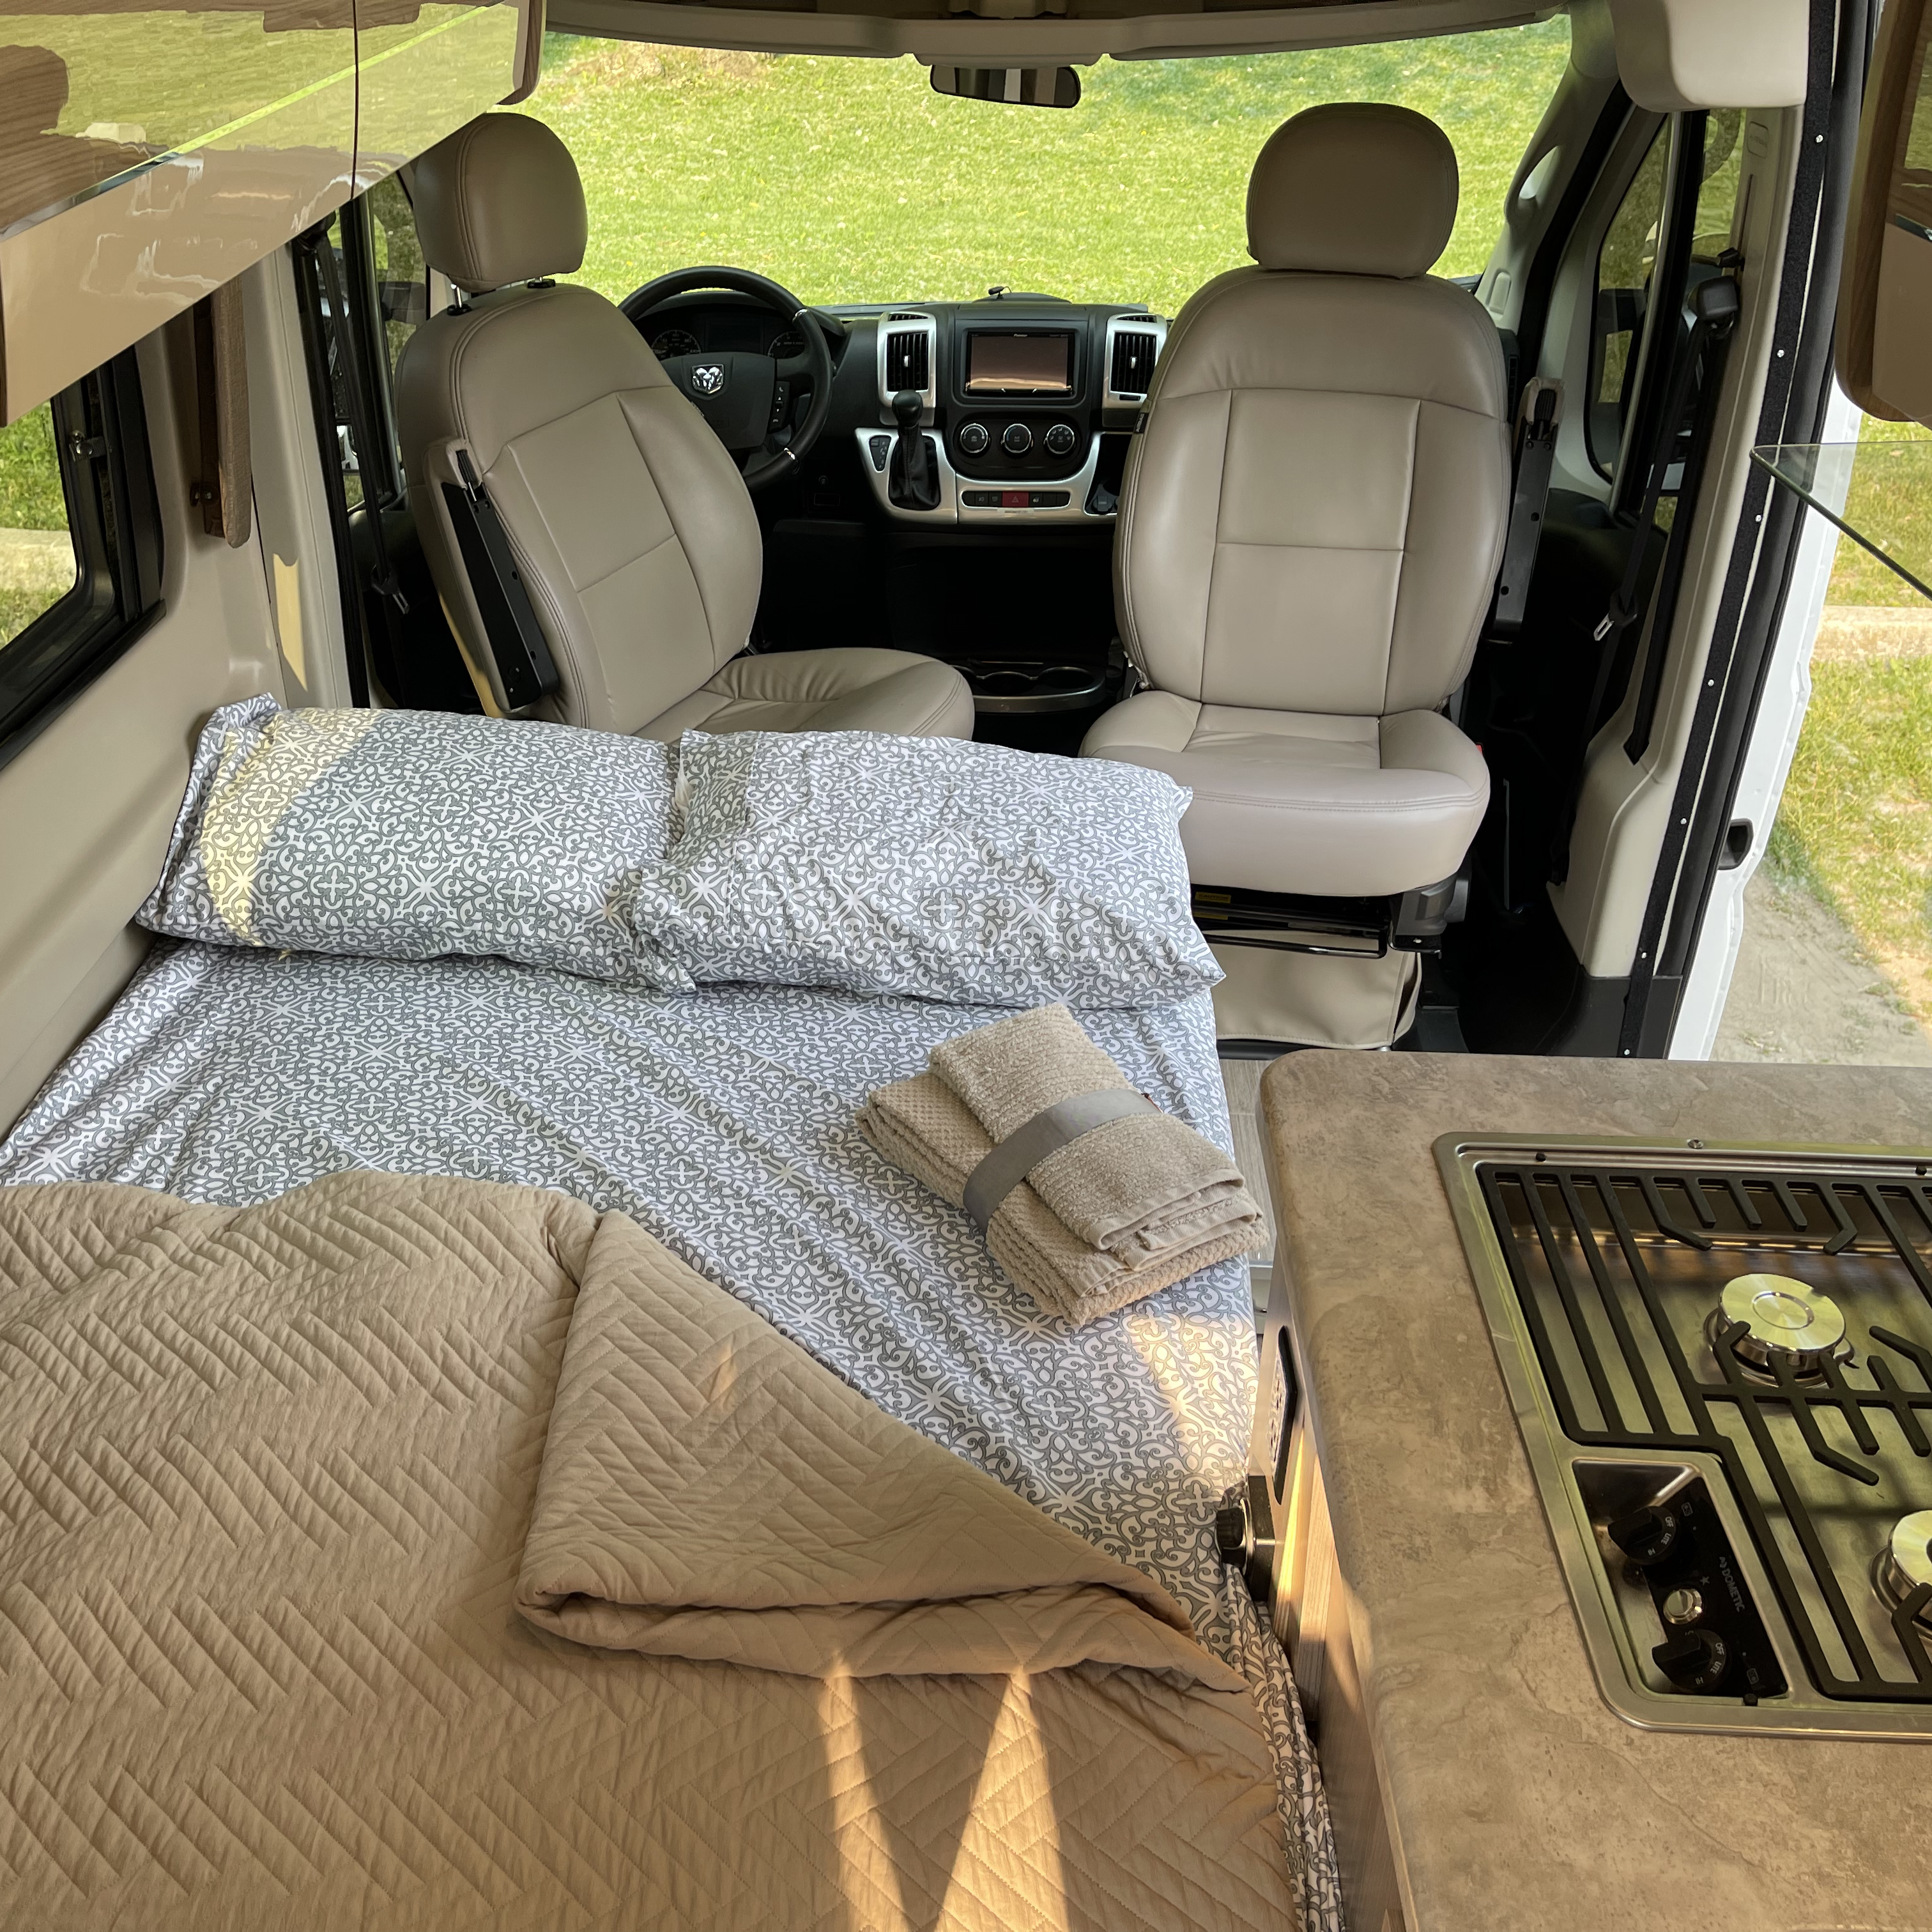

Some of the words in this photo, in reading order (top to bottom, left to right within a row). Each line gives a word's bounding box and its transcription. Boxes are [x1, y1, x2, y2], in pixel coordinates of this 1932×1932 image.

[1665, 1516, 1674, 1527] OFF
[1660, 1533, 1672, 1545] LITE
[1647, 1547, 1656, 1556] HI
[1722, 1567, 1745, 1613] DOMETIC
[1715, 1643, 1725, 1655] OFF
[1710, 1660, 1722, 1675] LITE
[1695, 1676, 1704, 1685] HI
